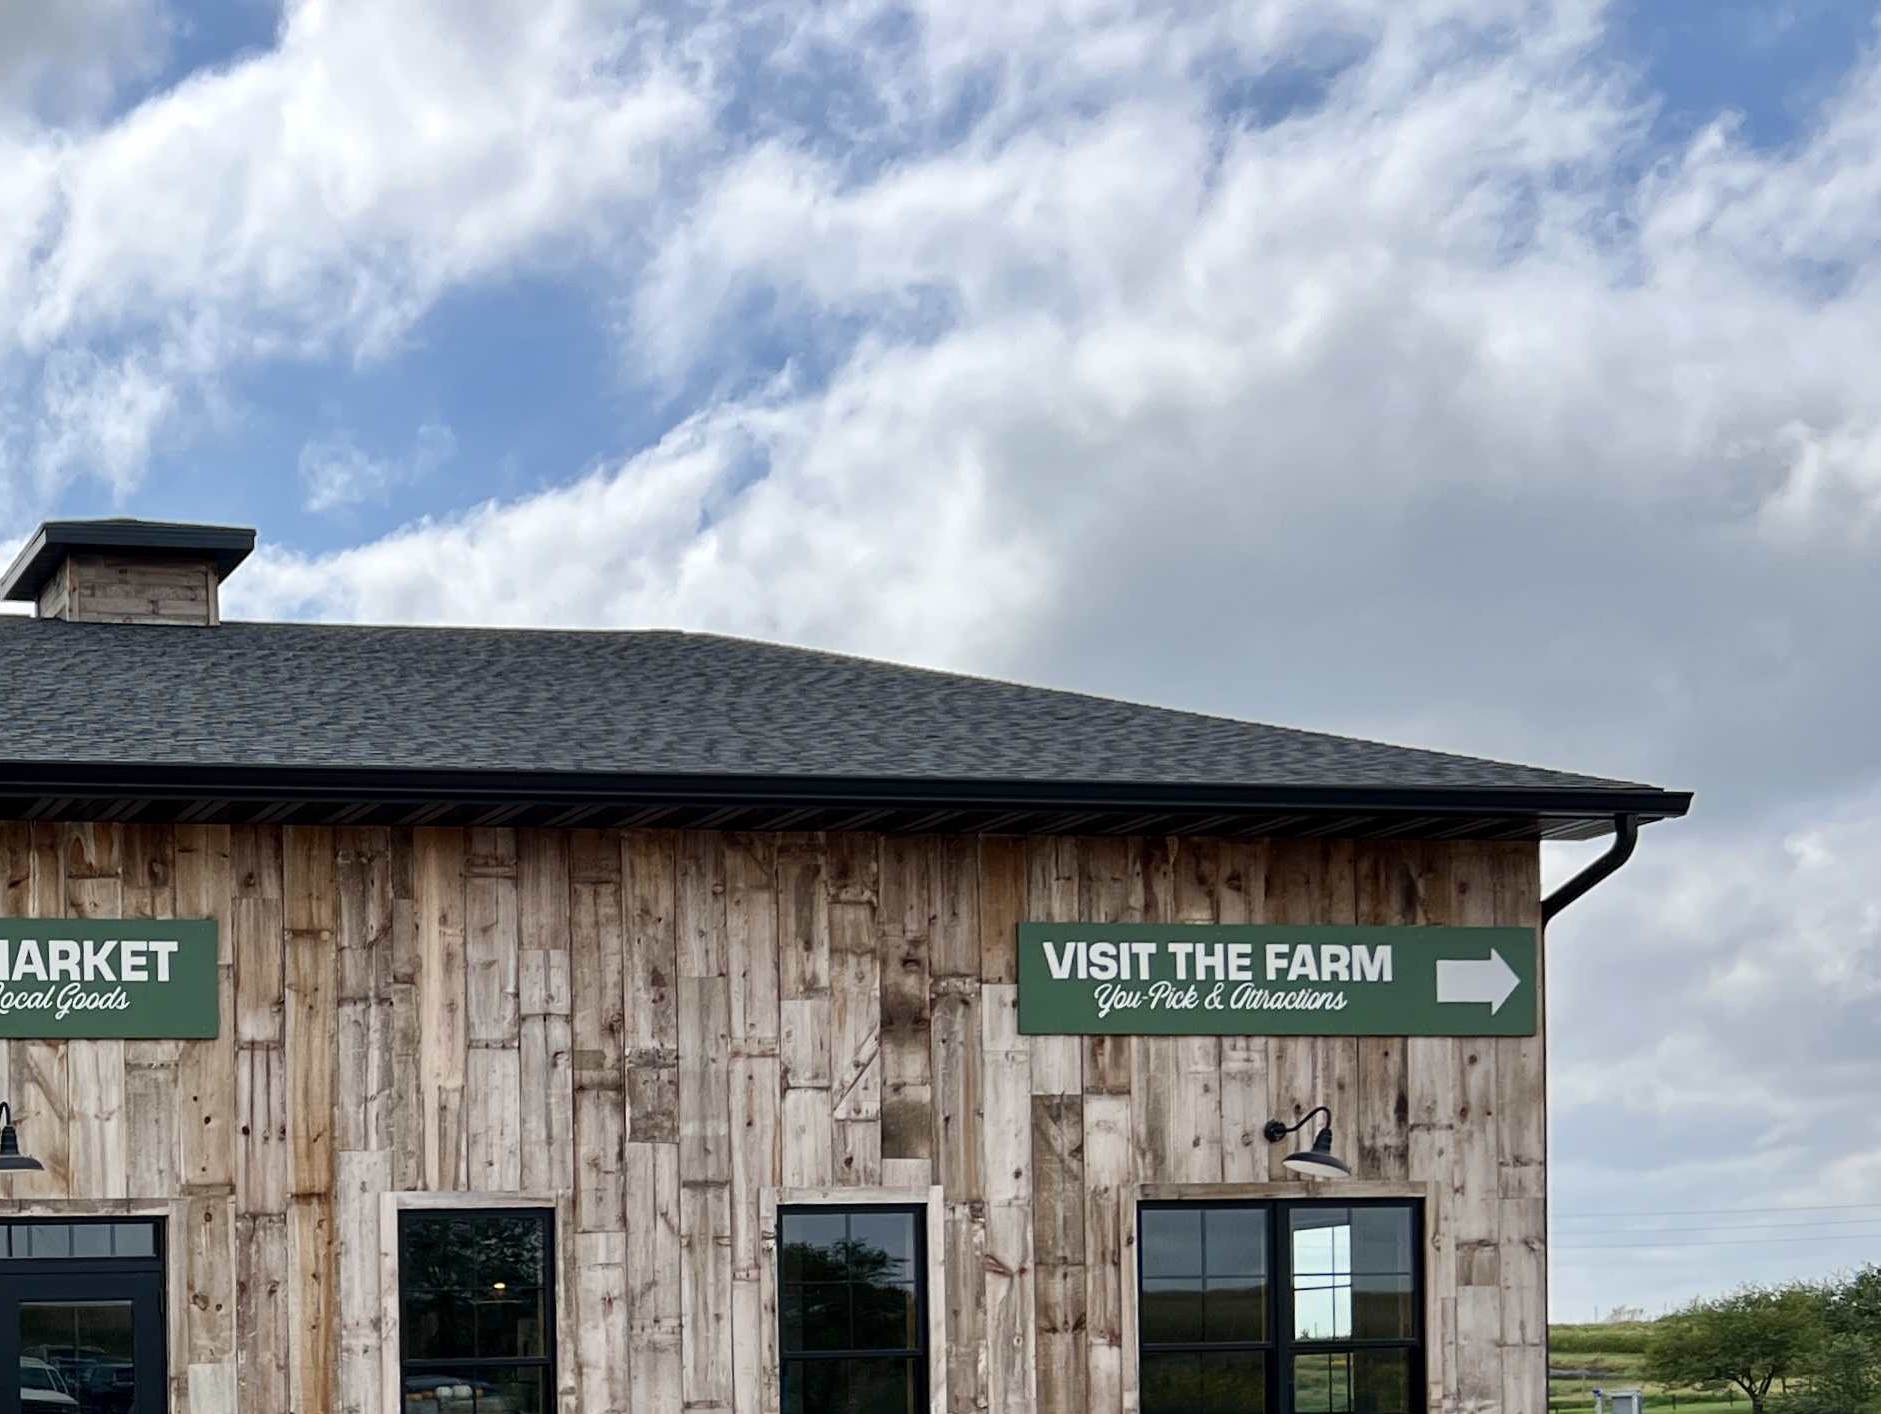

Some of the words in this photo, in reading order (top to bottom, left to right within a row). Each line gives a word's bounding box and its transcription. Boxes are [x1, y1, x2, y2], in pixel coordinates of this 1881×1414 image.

[1042, 941, 1157, 981] VISIT
[1167, 942, 1253, 981] THE
[1265, 943, 1393, 982] FARM
[55, 982, 131, 1020] Goods
[1093, 980, 1200, 1019] You-Pick
[1204, 981, 1225, 1010] &
[1229, 982, 1348, 1010] Attractions
